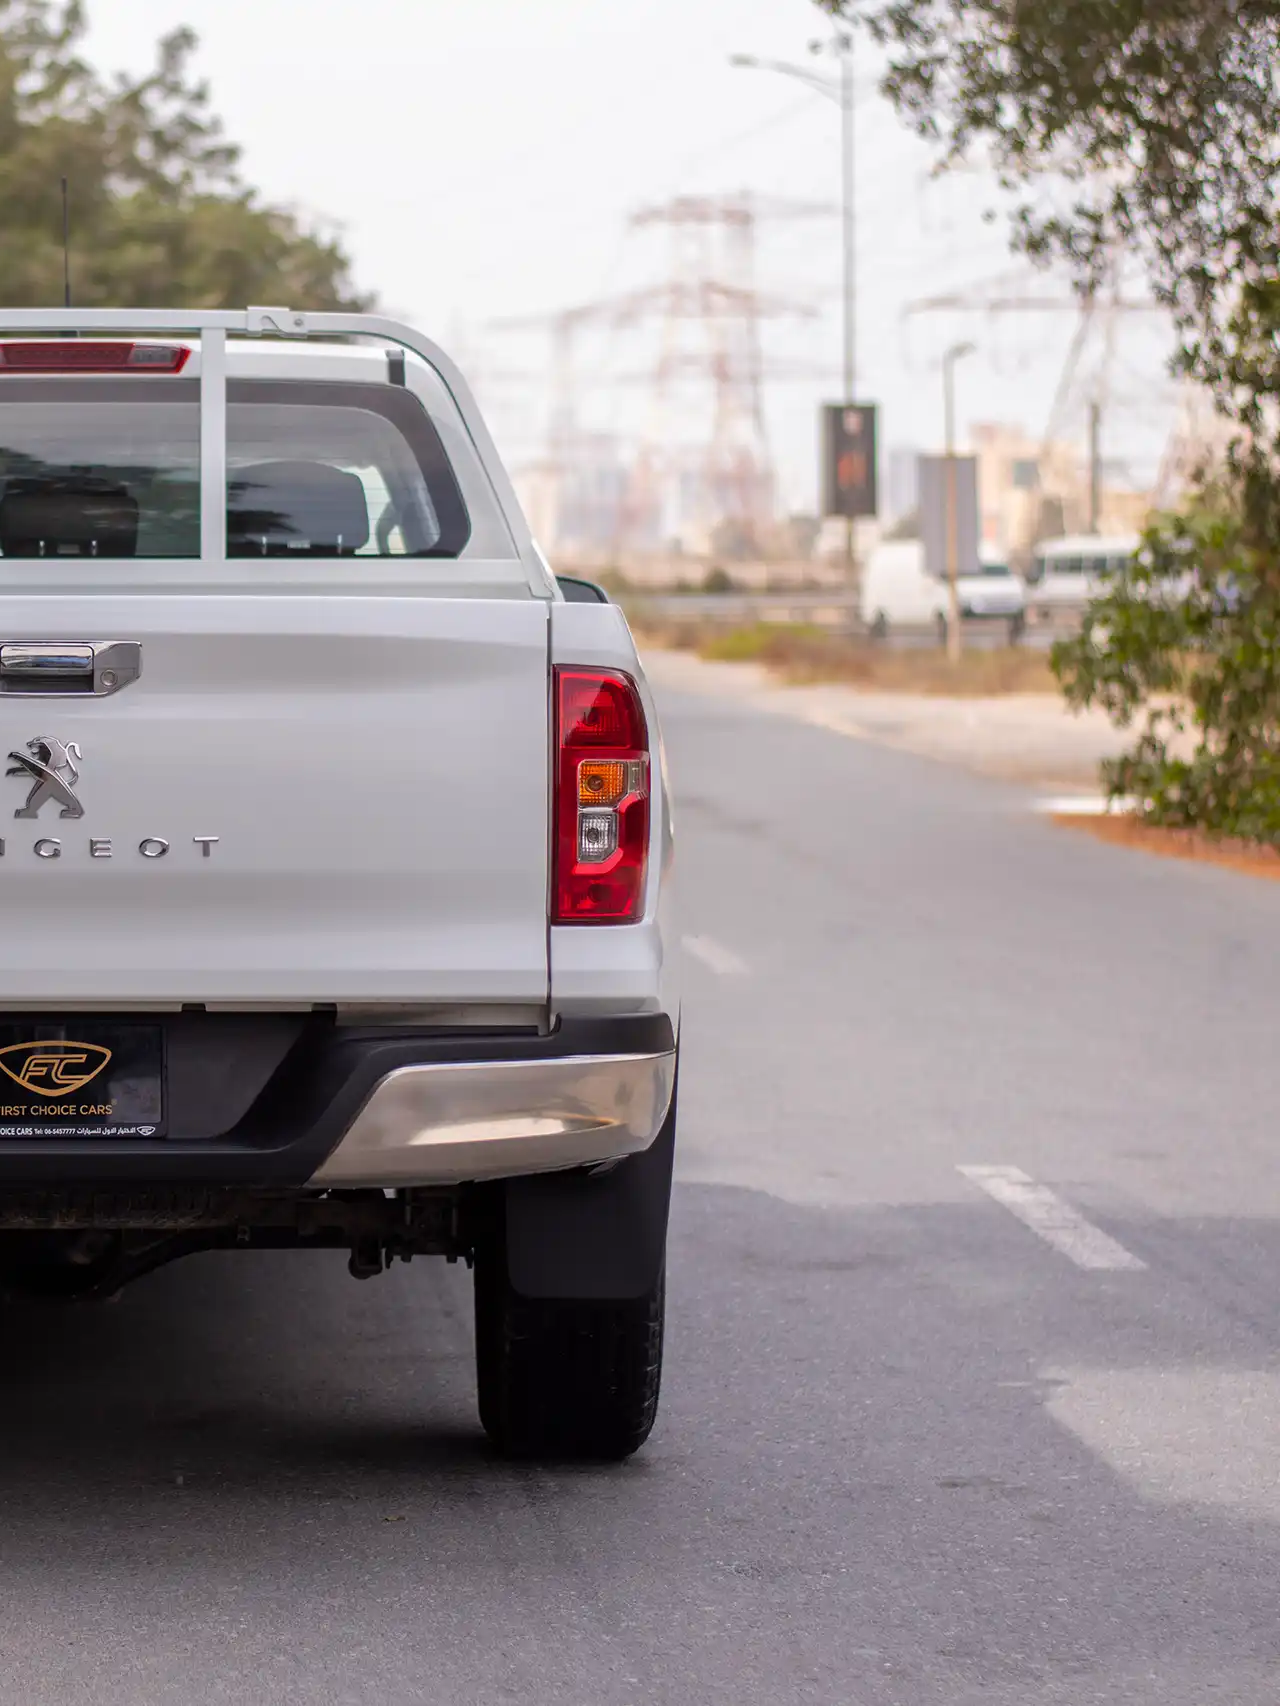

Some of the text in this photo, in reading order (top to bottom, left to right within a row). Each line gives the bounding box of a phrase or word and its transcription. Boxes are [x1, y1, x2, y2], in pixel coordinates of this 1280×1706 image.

[30, 1105, 77, 1116] CHOICE
[80, 1104, 113, 1115] CARS
[16, 1127, 33, 1136] CARS
